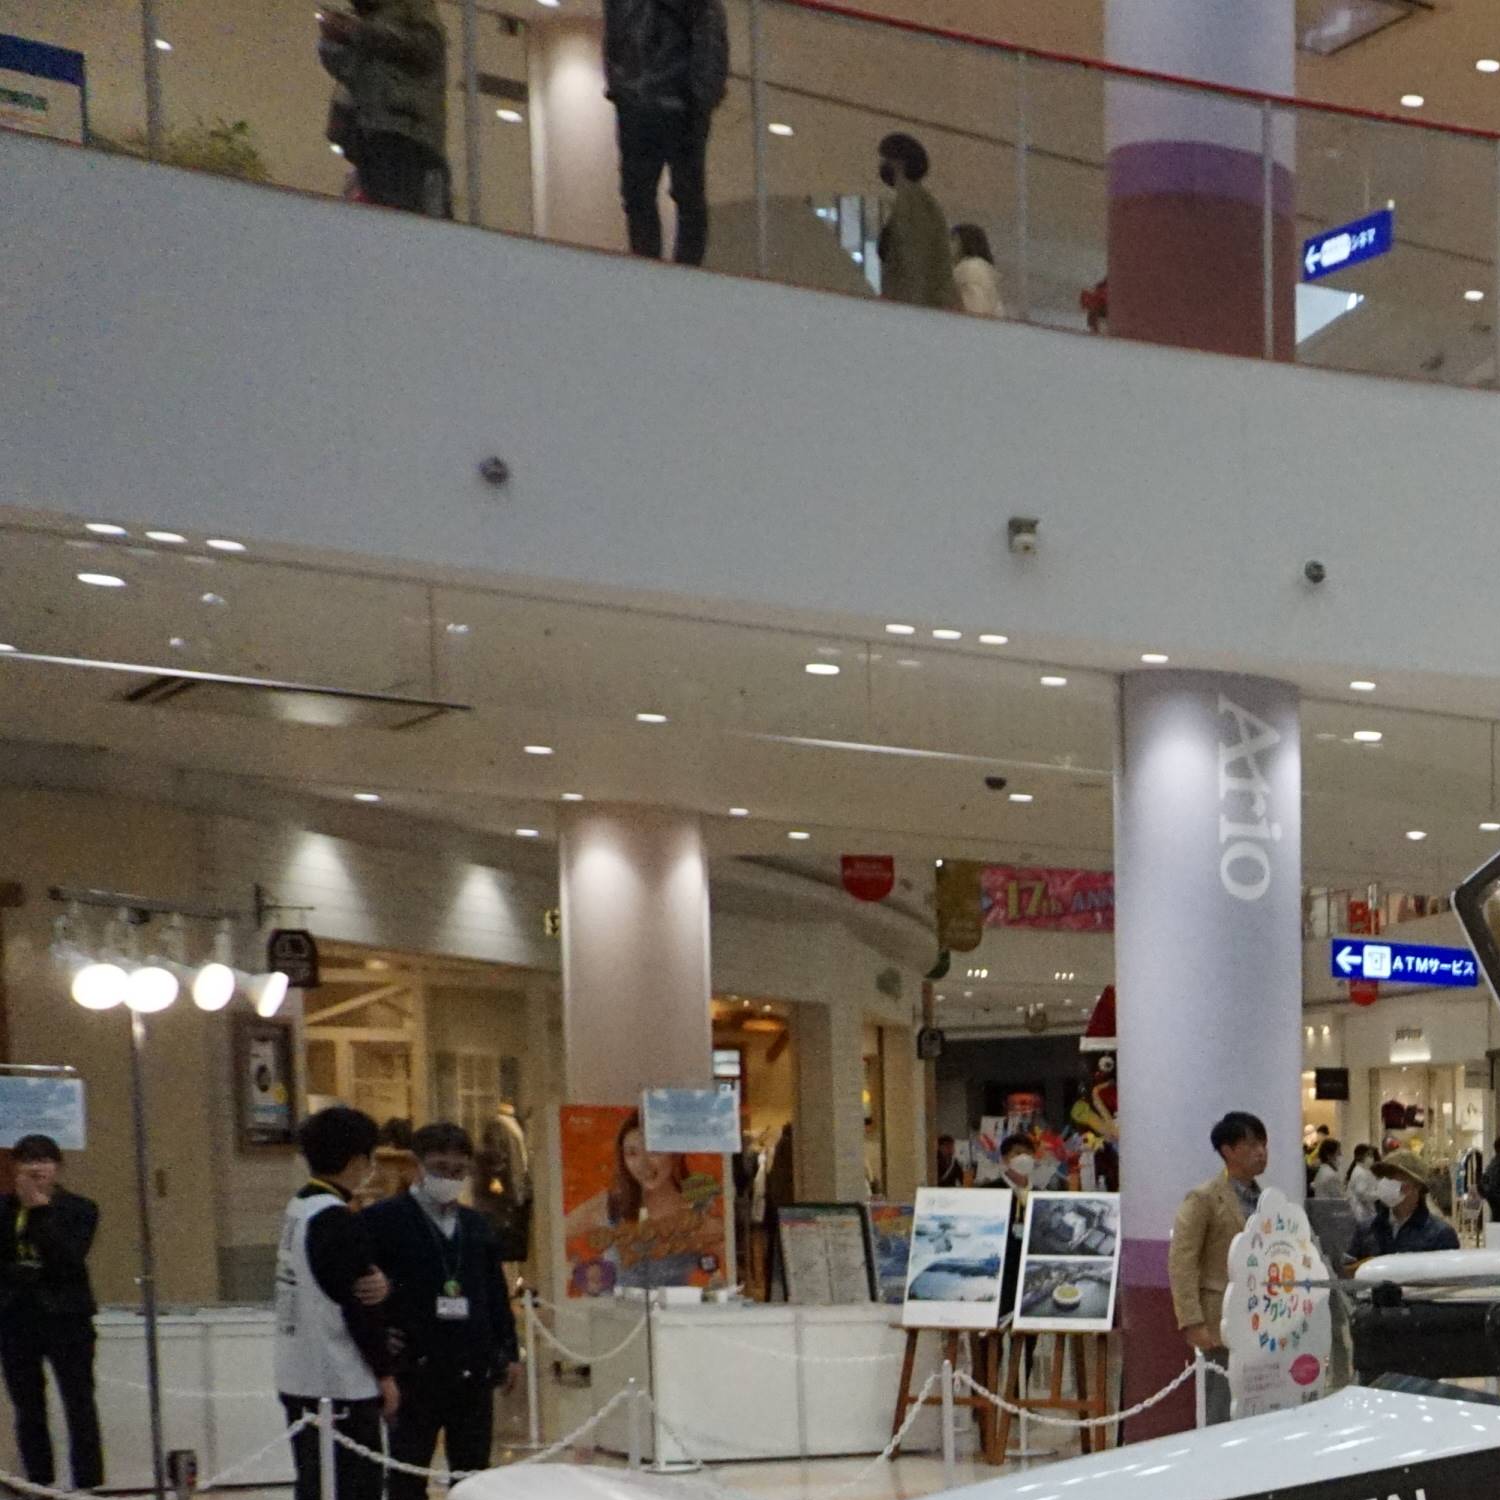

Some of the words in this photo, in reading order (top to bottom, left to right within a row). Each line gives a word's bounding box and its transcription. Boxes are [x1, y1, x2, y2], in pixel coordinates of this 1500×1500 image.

[1218, 694, 1283, 900] Ario
[1392, 955, 1476, 977] ATMサービス
